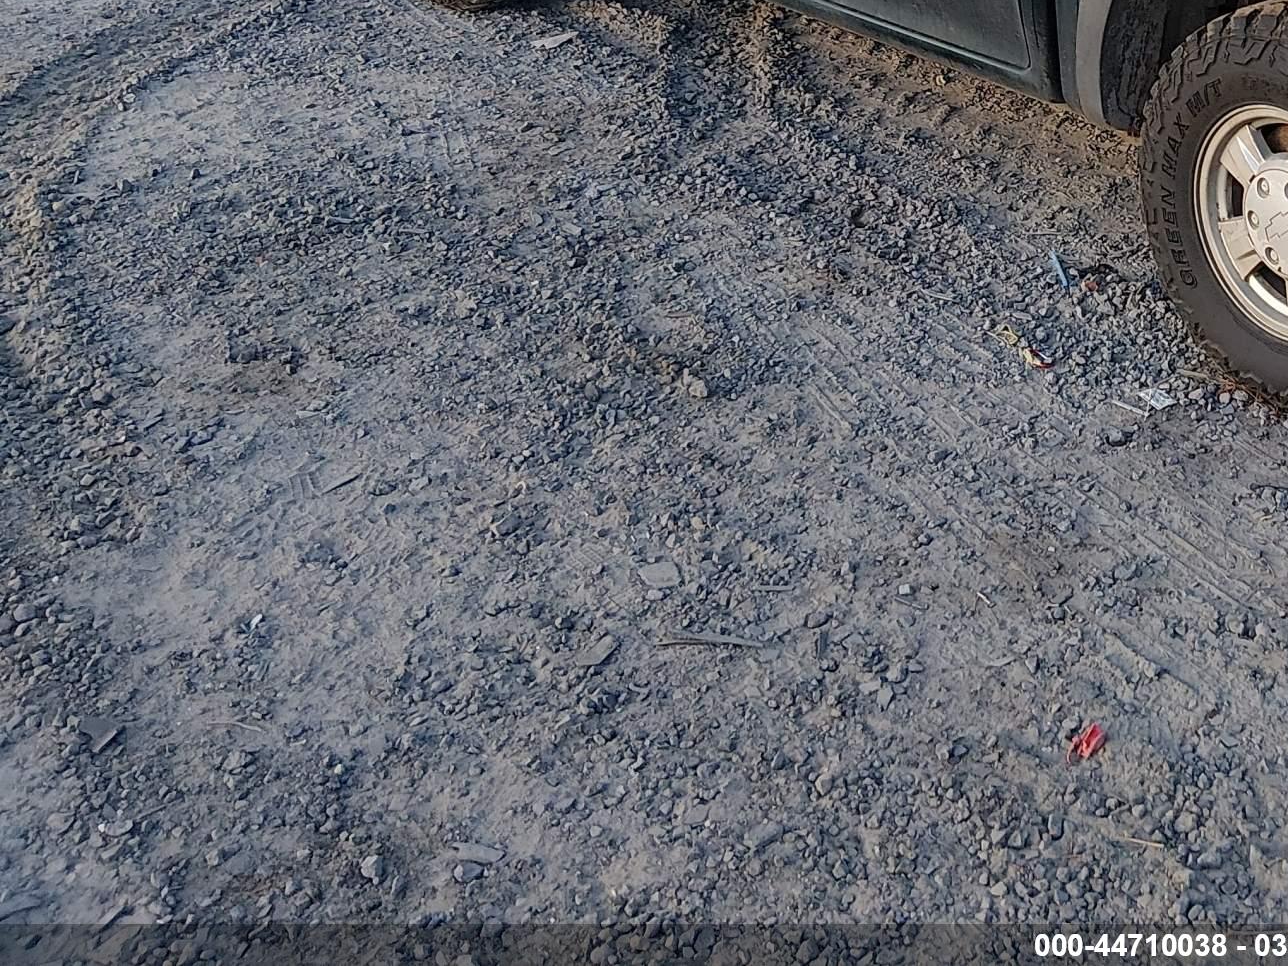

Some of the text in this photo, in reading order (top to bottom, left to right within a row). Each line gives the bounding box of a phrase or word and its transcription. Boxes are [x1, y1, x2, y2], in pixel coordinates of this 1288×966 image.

[1160, 77, 1223, 290] GREEN MAX M/T
